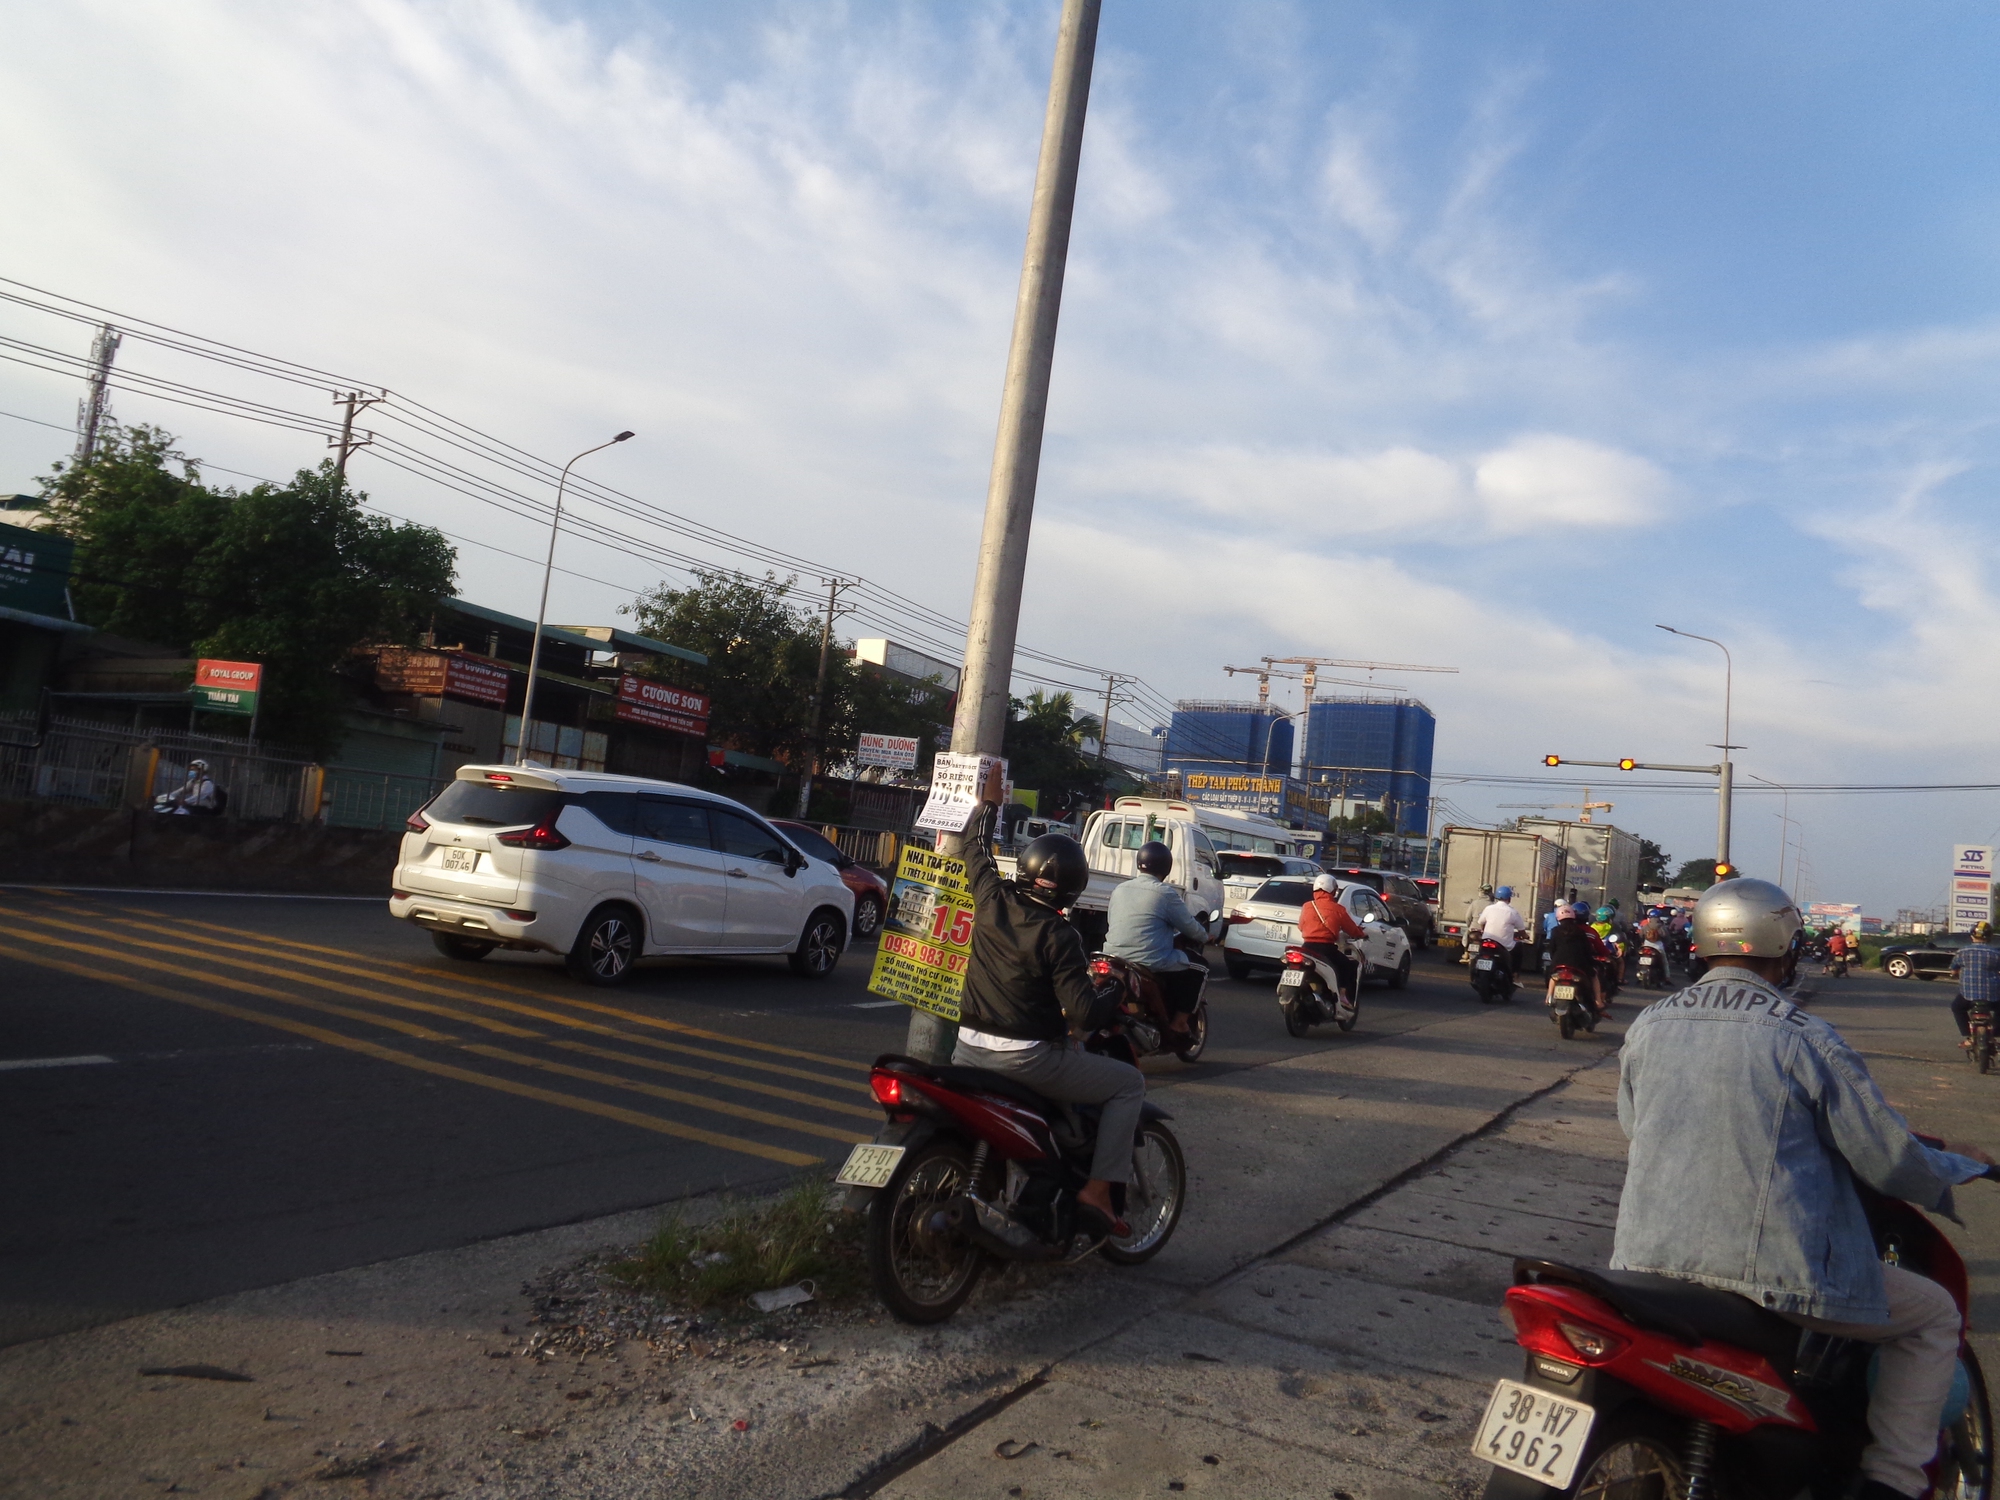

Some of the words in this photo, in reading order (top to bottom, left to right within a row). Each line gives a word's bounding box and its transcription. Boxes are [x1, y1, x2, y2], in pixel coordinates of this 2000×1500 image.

[210, 668, 231, 679] ROYAL
[232, 671, 254, 680] GROUP
[860, 734, 884, 748] HÙNG
[936, 757, 951, 766] BÁN
[1187, 772, 1208, 789] THÉP
[1209, 776, 1227, 790] TAM
[1227, 775, 1250, 792] PHÚC
[1251, 776, 1282, 793] THÀNH
[452, 850, 466, 860] 60K
[906, 850, 924, 867] NHÀ
[927, 856, 943, 870] TRẢ
[945, 860, 963, 876] GÓP
[445, 860, 470, 871] 007.46
[922, 872, 926, 880] 2
[932, 904, 975, 946] 1,5
[884, 934, 917, 958] 0933
[919, 945, 945, 967] 983
[896, 959, 915, 972] RIÊNG
[940, 974, 959, 986] 100%
[855, 1148, 895, 1166] 73-D1
[841, 1164, 892, 1184] 242.76
[1540, 1363, 1568, 1377] HONDA
[1502, 1389, 1578, 1438] 38-H7
[1488, 1425, 1564, 1478] 4962
